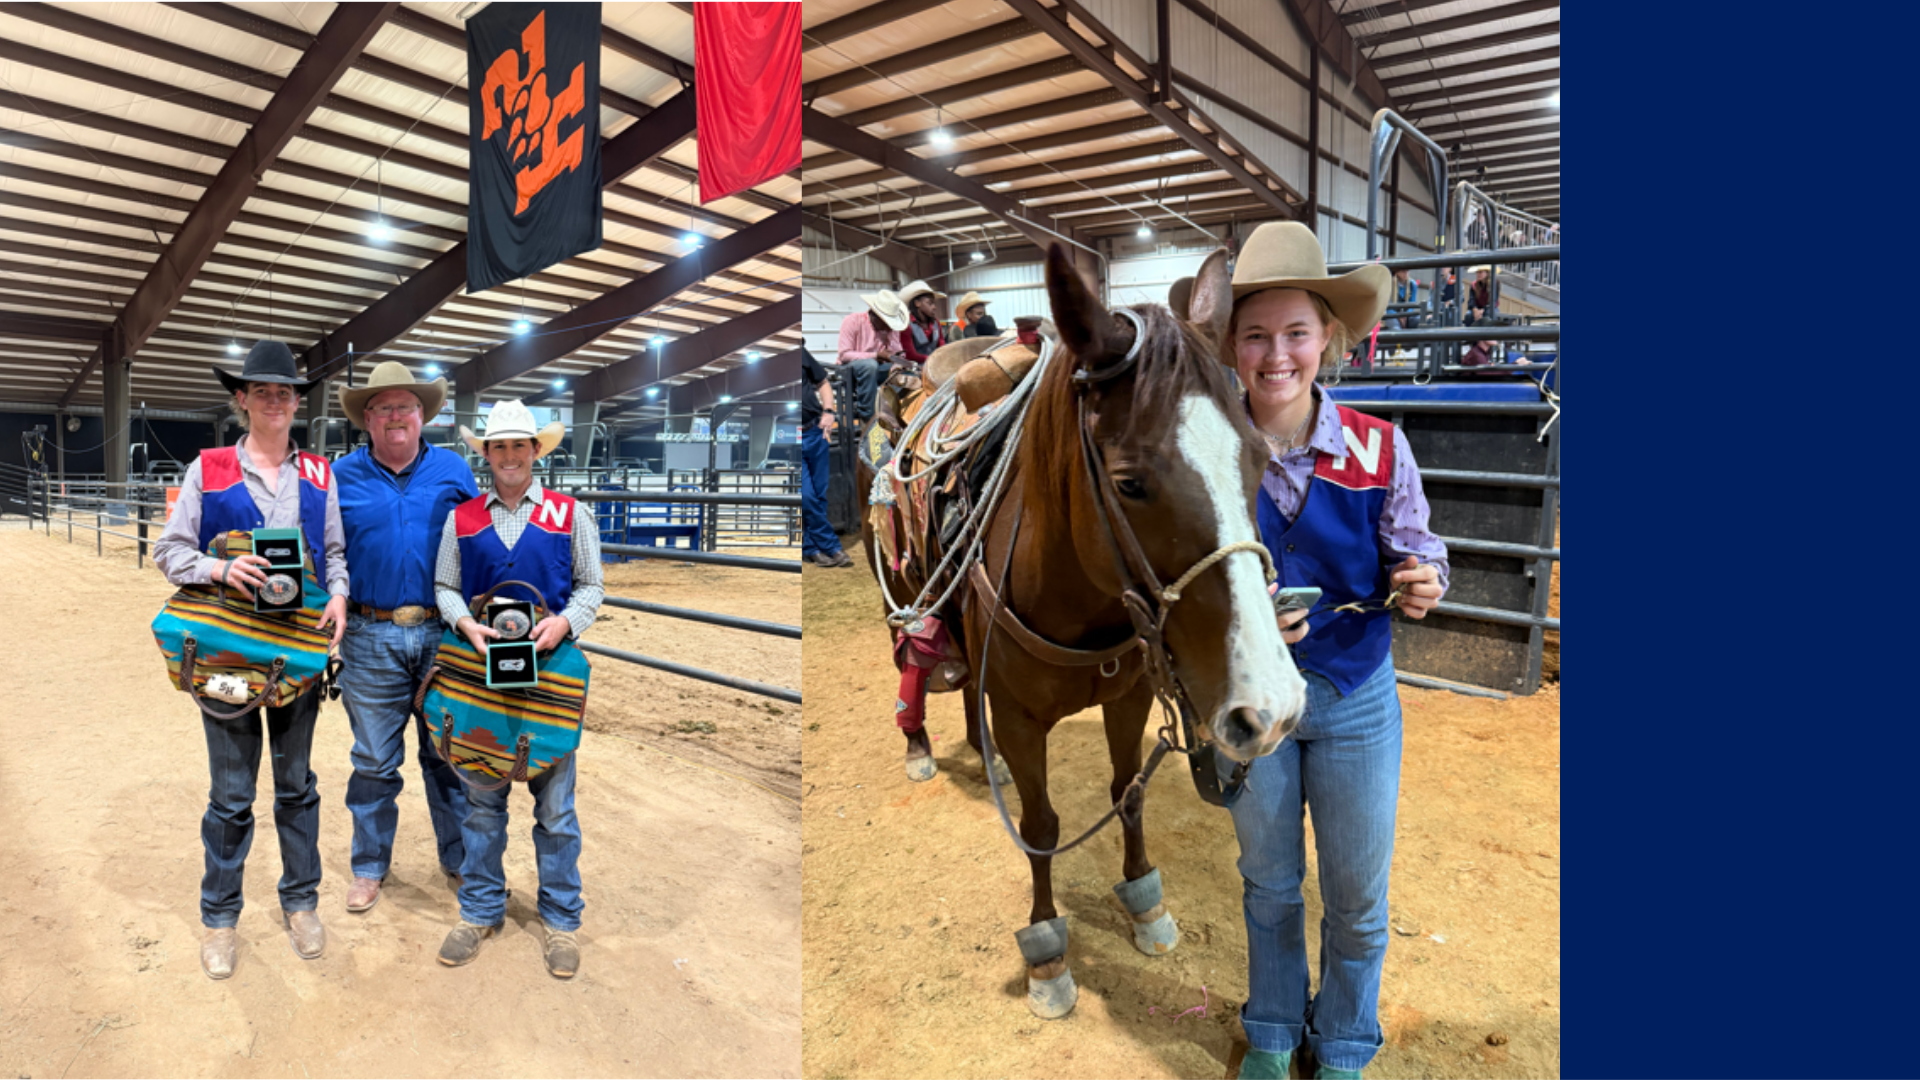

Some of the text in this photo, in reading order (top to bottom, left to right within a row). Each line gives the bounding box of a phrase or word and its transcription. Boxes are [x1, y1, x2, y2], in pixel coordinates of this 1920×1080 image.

[1332, 425, 1382, 475] N
[303, 458, 324, 486] N
[539, 499, 568, 528] N
